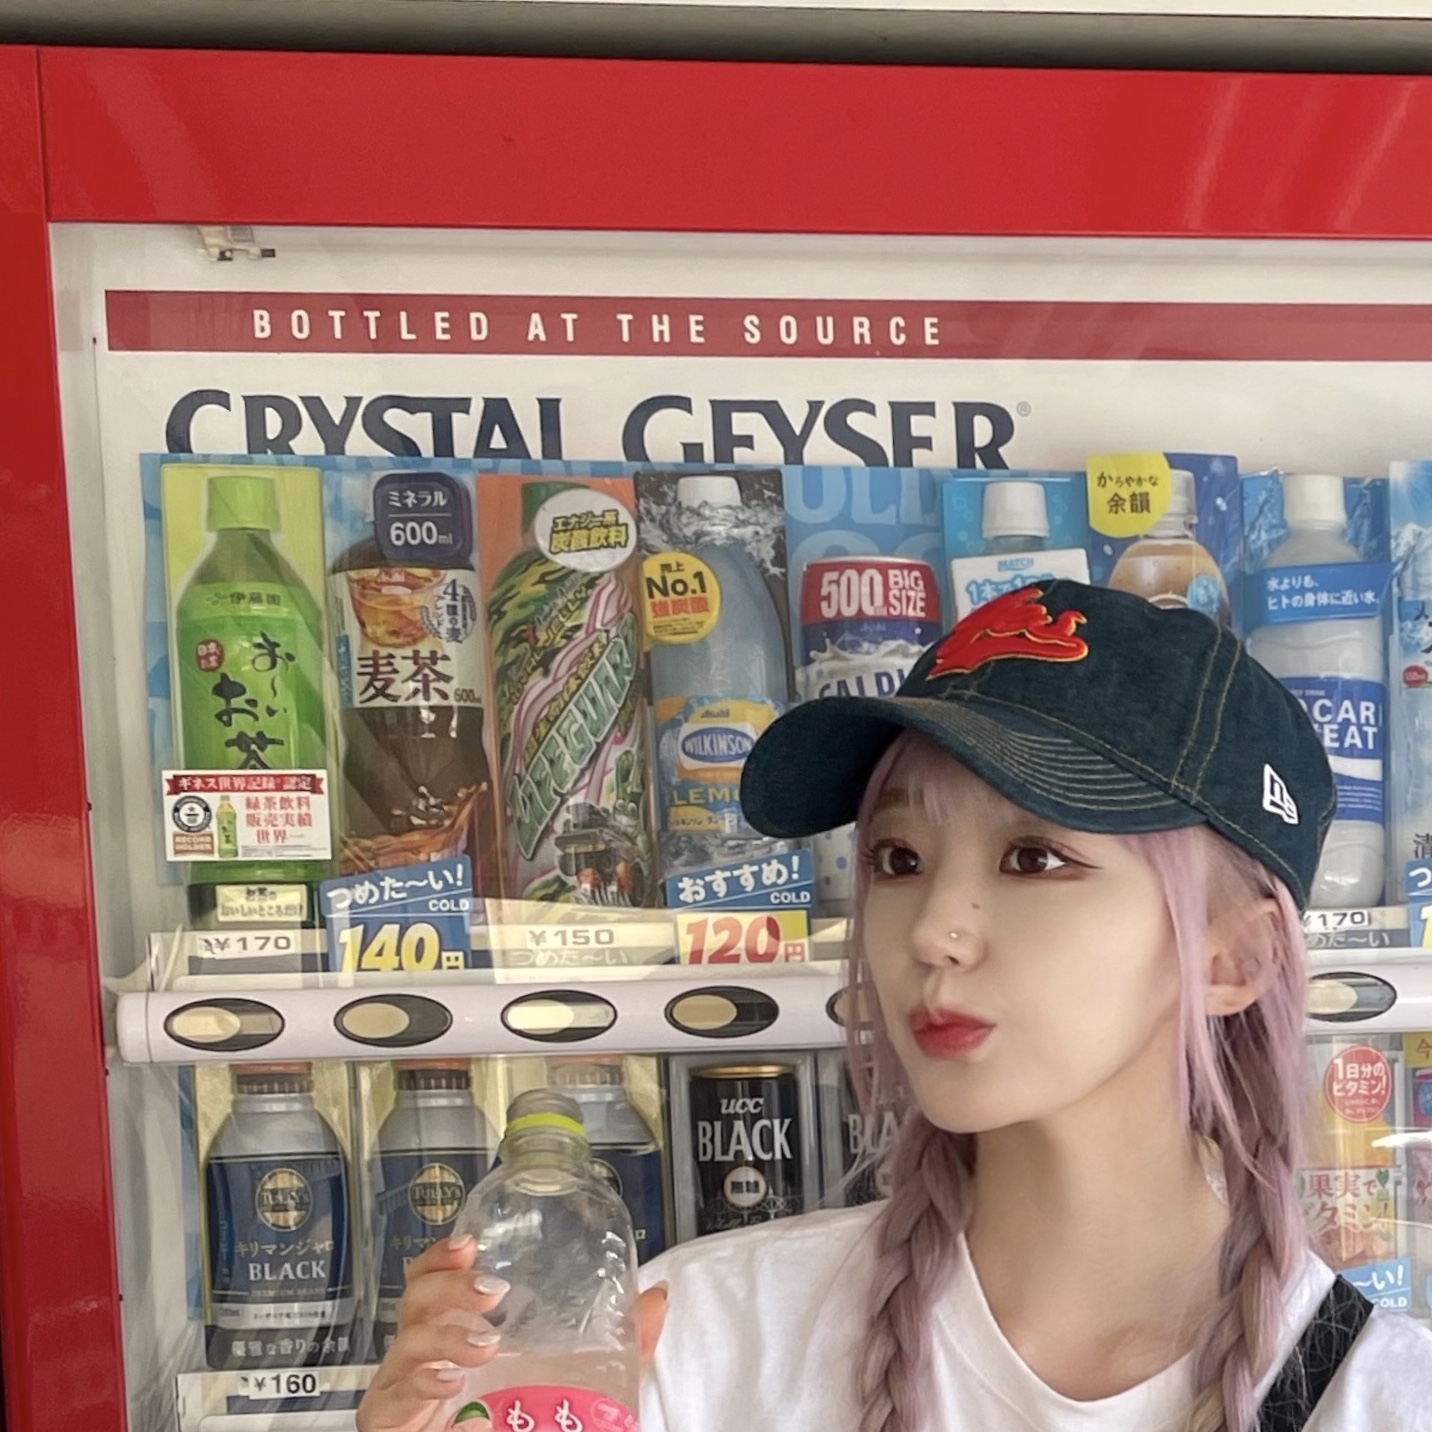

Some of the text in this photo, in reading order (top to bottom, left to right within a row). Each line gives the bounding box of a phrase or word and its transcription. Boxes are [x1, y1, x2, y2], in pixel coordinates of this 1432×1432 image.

[252, 309, 940, 345] BOTTLED AT THE SOURCE
[1096, 471, 1159, 489] かろやかな
[388, 490, 448, 507] ミネラル
[1106, 491, 1152, 515] 余韻
[389, 520, 454, 547] 600ml
[645, 570, 707, 599] No.1
[887, 569, 925, 591] BIG
[888, 588, 926, 618] SIZE
[356, 649, 455, 704] 麦茶
[682, 732, 753, 758] WILKINSON
[678, 855, 801, 904] おすすめ!
[427, 898, 470, 912] COLD
[769, 891, 811, 904] COLD
[214, 935, 292, 952] ¥170
[528, 927, 615, 946] ¥150
[697, 1118, 793, 1163] BLACK
[1308, 1172, 1379, 1199] 果実で
[235, 1240, 336, 1257] キリマンジャロ
[248, 1262, 327, 1282] BLACK
[252, 1373, 318, 1394] ¥160
